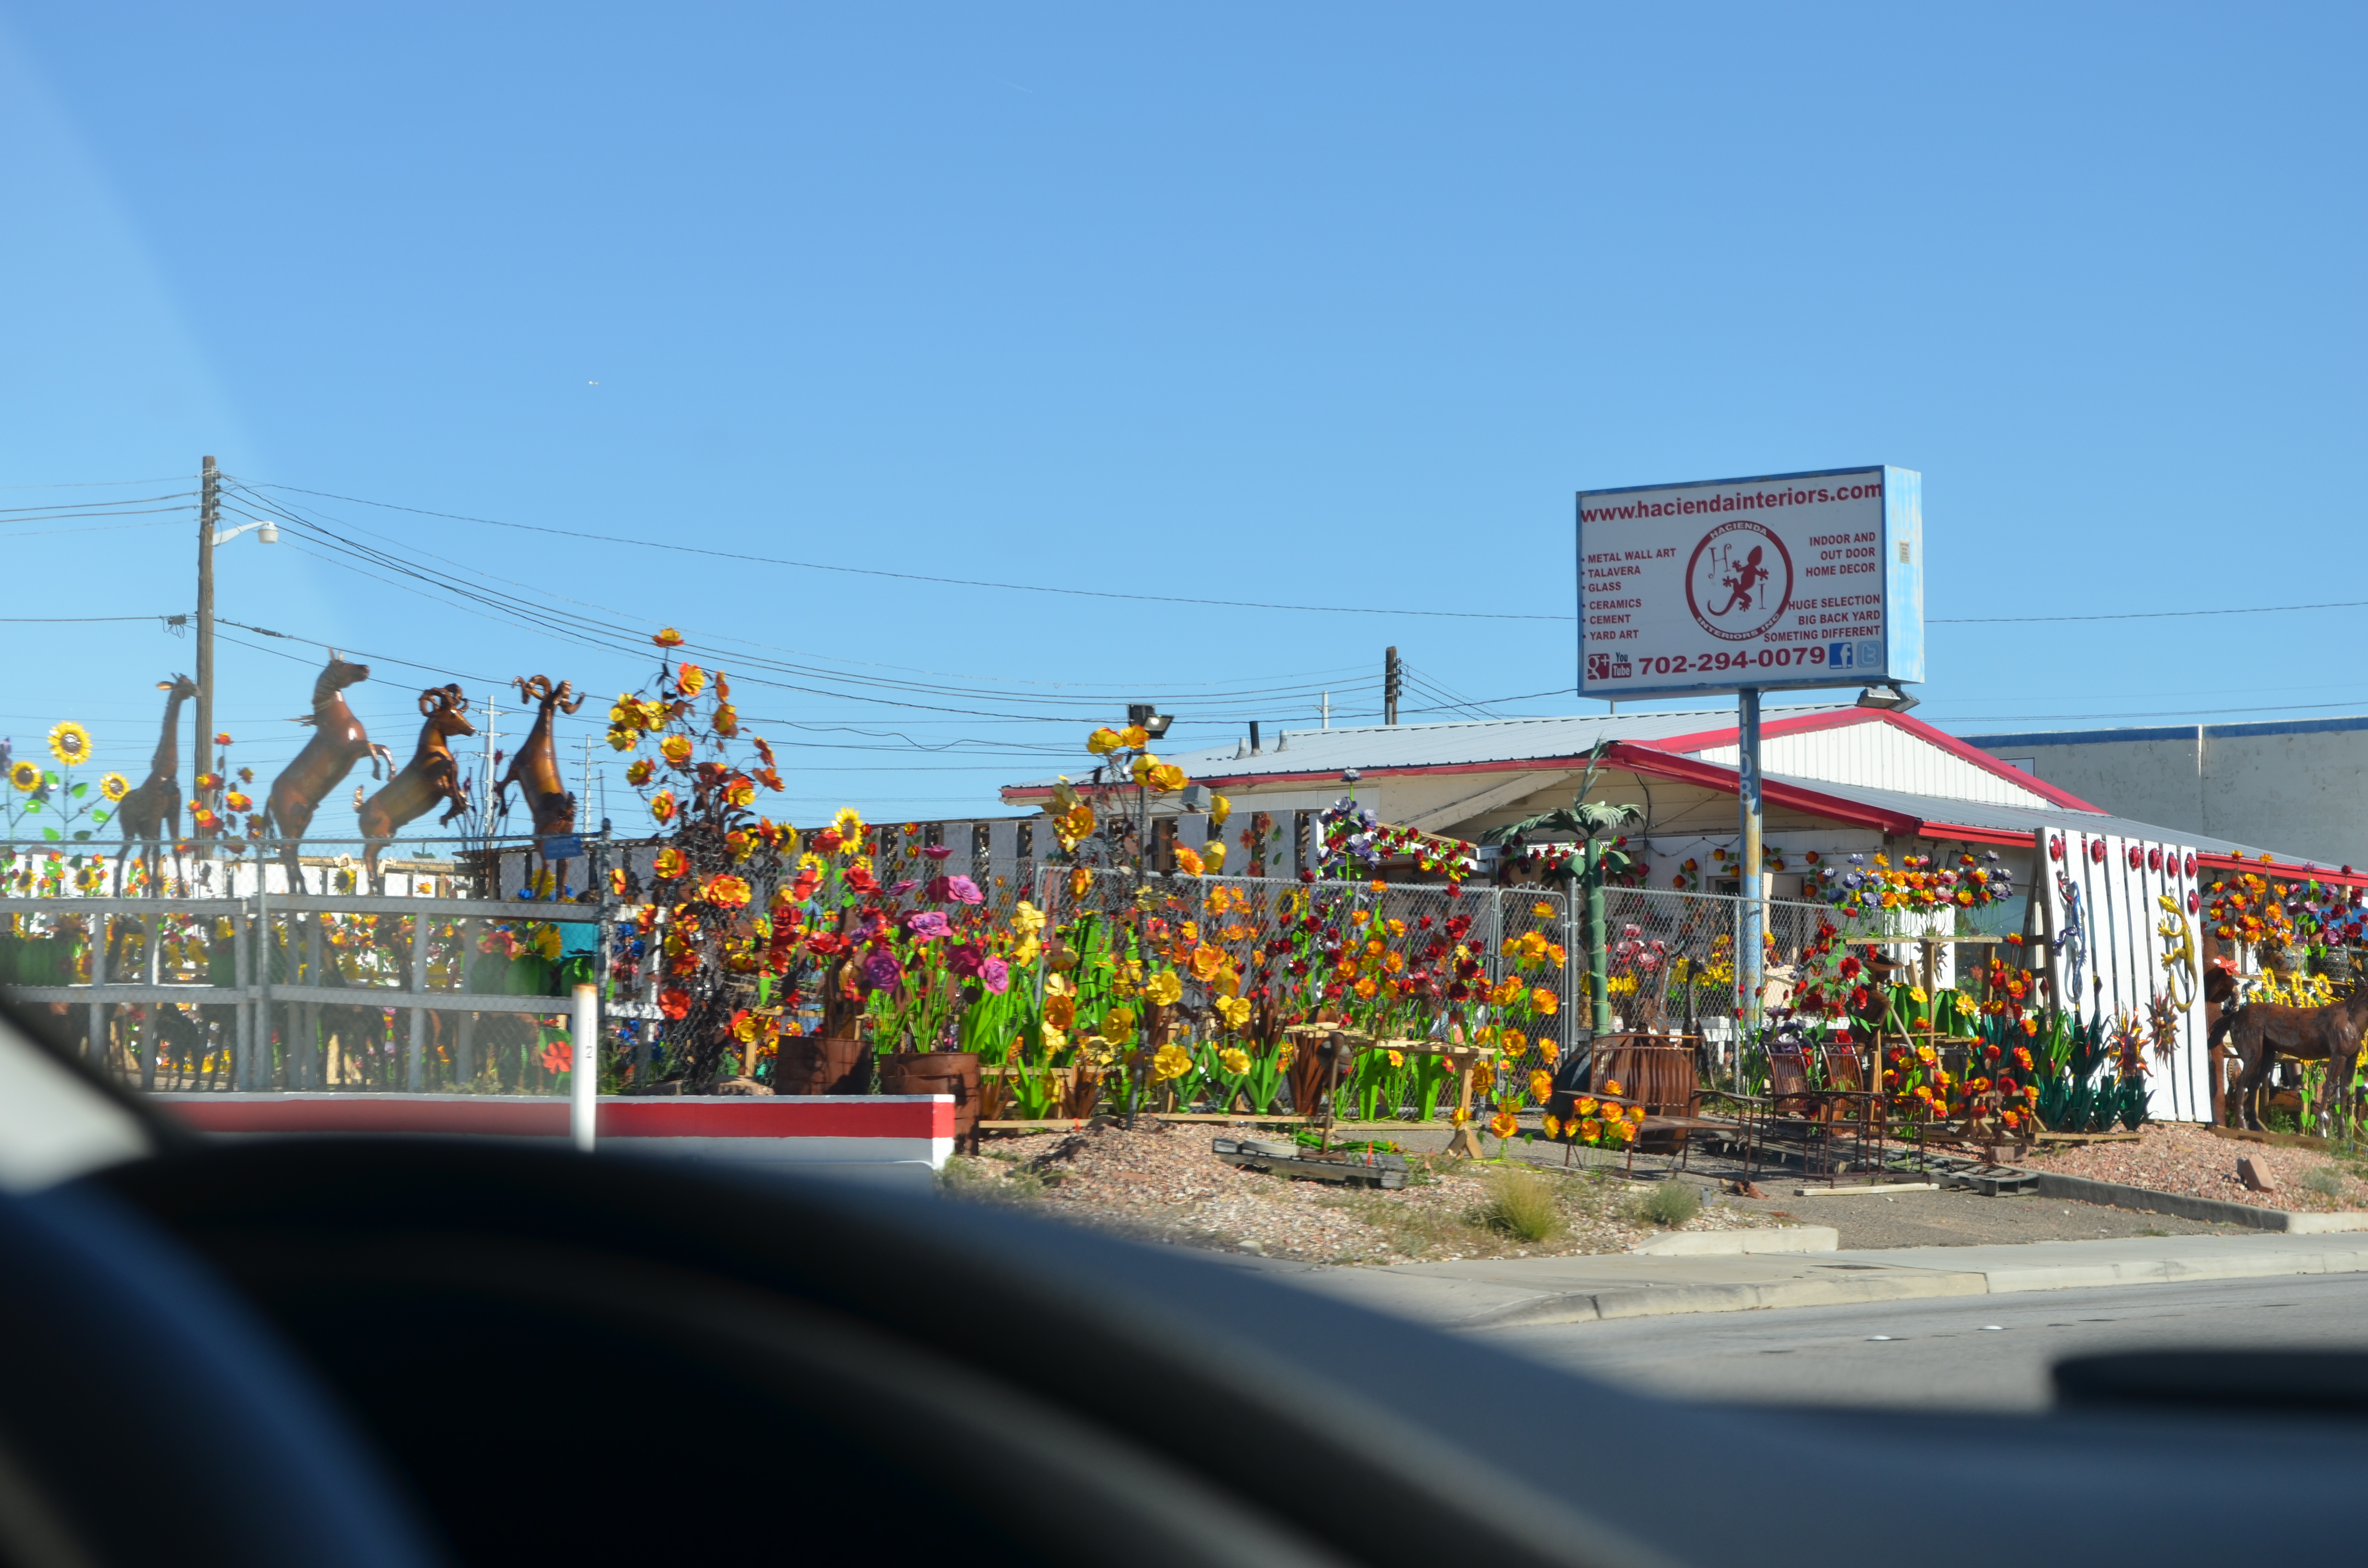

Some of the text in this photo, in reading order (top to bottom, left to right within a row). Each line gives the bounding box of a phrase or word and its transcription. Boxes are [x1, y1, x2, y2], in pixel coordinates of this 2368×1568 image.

[1581, 484, 1881, 522] www.haciendainteriors.com
[1710, 522, 1767, 539] HACIENDA
[1810, 532, 1875, 546] INDOOR AND
[1588, 548, 1676, 564] METAL WALL ART
[1821, 547, 1875, 561] OUT DOOR
[1588, 566, 1640, 577] TALAVERA
[1806, 563, 1875, 577] HOME DECOR
[1589, 582, 1621, 592] GLASS
[1590, 599, 1641, 610] CERAMICS
[1788, 594, 1880, 610] HUGE SELECTION
[1590, 614, 1631, 625] CEMENT
[1798, 610, 1880, 625] BIG BACK YARD
[1697, 613, 1780, 639] INTERIORS INC
[1590, 630, 1639, 640] YARD ART
[1764, 625, 1881, 642] SOMETING DIFFERENT
[1616, 652, 1628, 662] You
[1639, 646, 1825, 675] 702-294-0079
[1614, 665, 1630, 676] Tube
[1739, 700, 1752, 804] 1108
